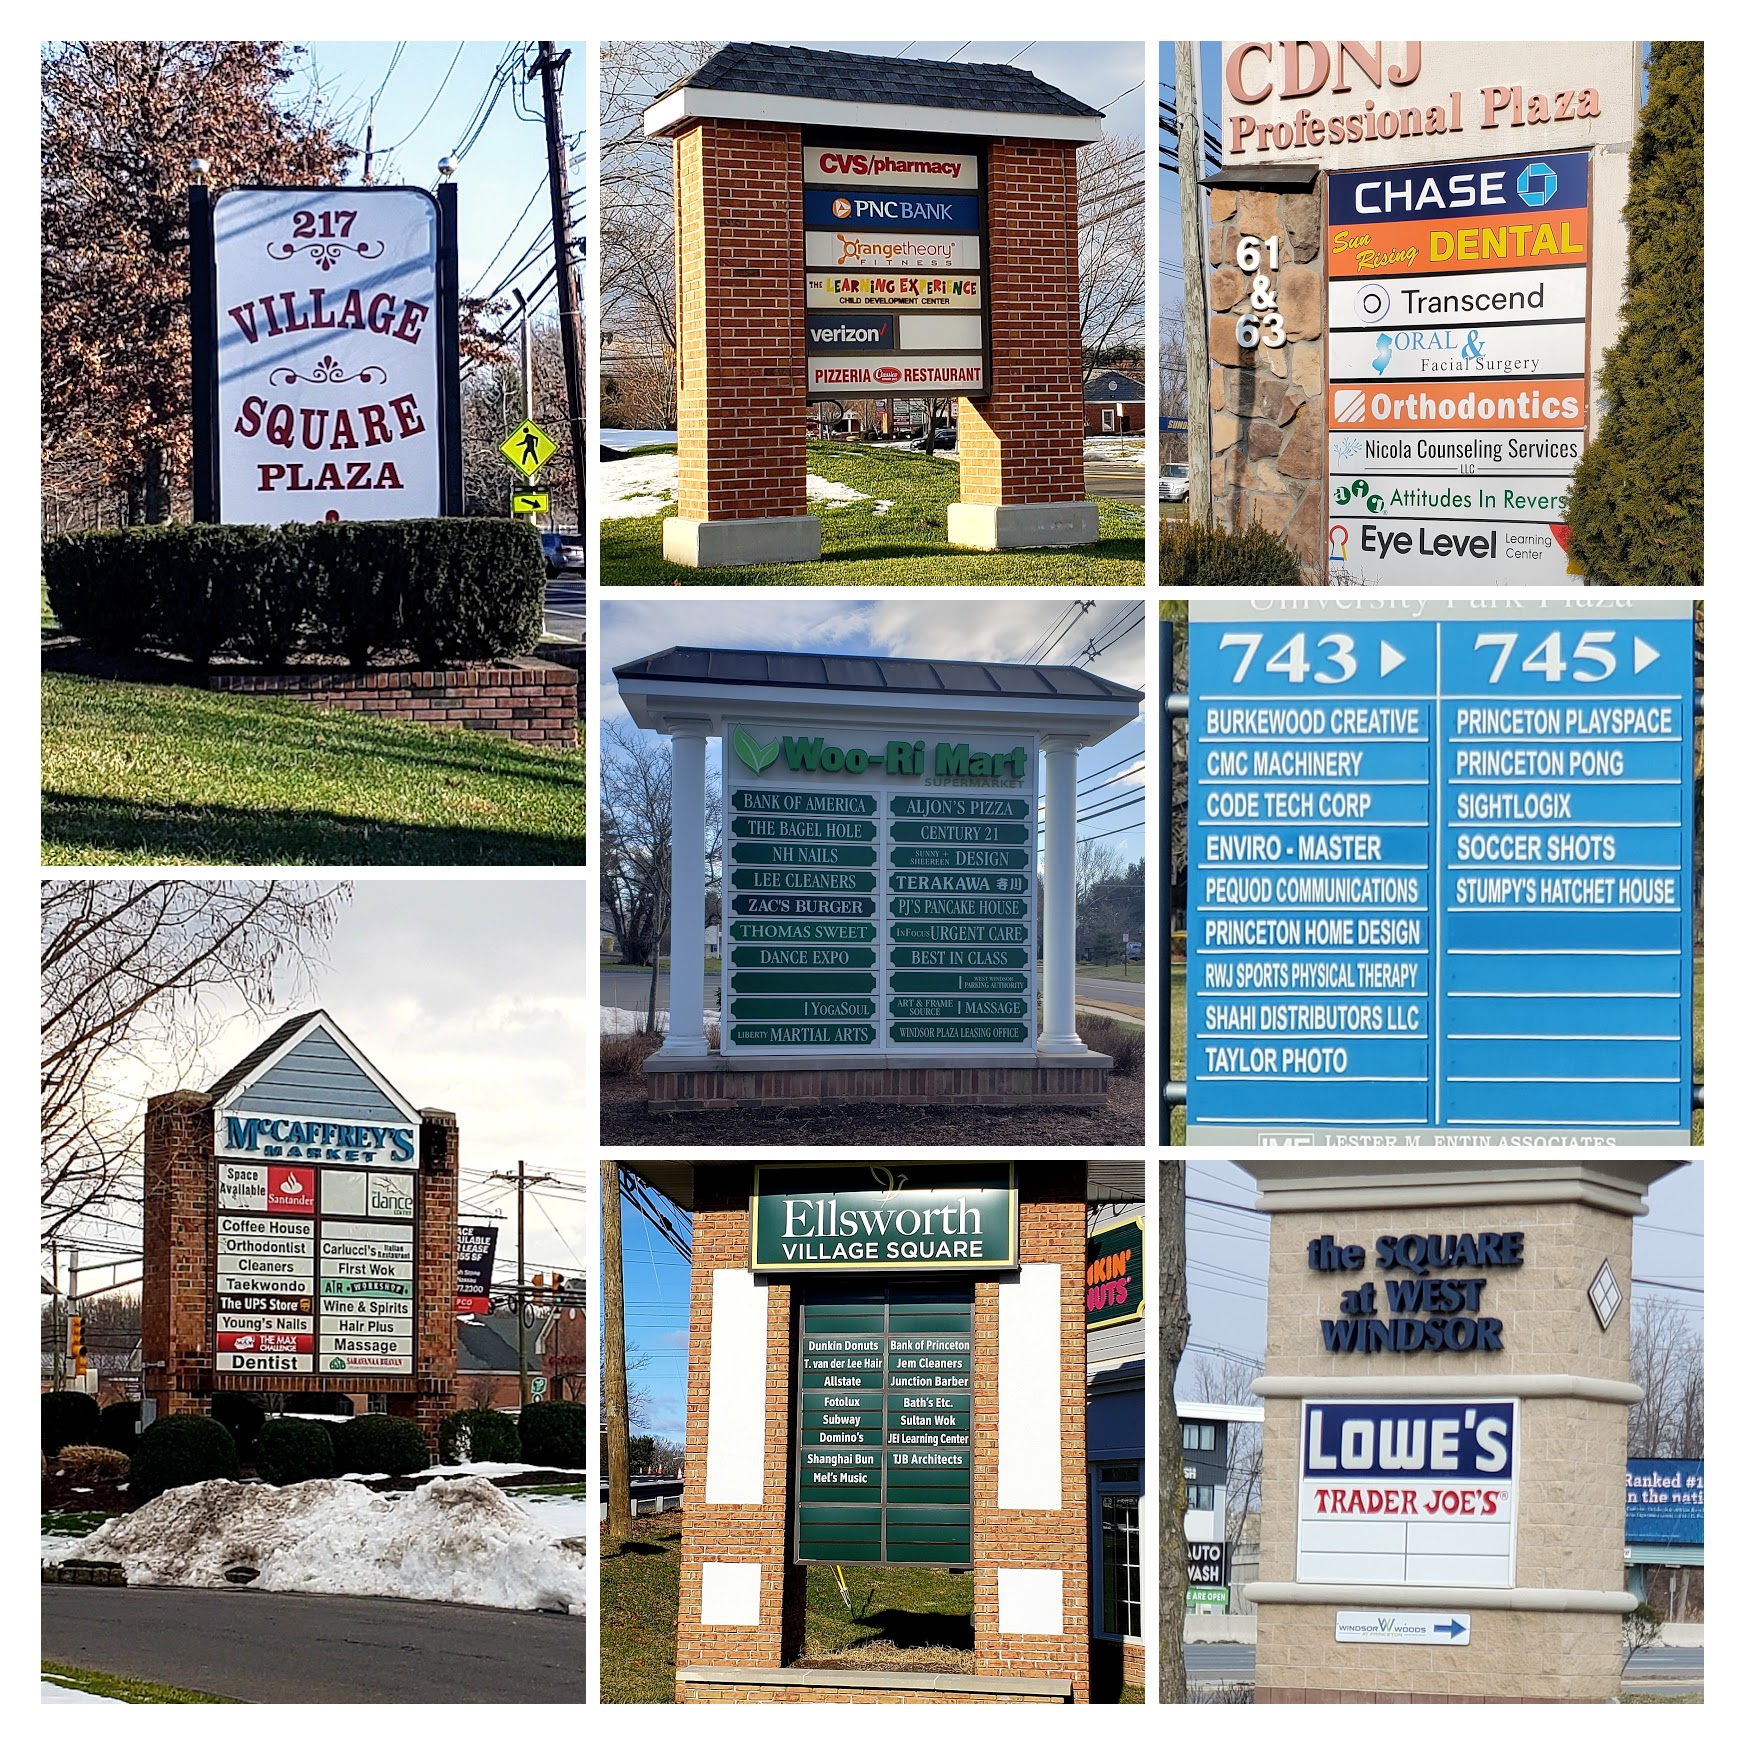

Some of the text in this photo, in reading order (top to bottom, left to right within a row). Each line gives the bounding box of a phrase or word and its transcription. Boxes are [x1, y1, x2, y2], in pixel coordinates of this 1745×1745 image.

[1225, 41, 1423, 104] CDNJ
[1480, 85, 1601, 130] Plaza
[1229, 91, 1463, 155] Professional
[820, 153, 961, 178] CVS/pharmacy
[1355, 171, 1506, 215] CHASE
[292, 210, 358, 239] 217
[1429, 221, 1584, 264] DENTAL
[1235, 236, 1281, 274] 61
[864, 297, 950, 305] DEVELOPMENT CENTER
[1401, 283, 1545, 316] Transcend
[228, 288, 429, 345] VILLAGE
[810, 324, 880, 342] verizon
[1235, 313, 1288, 350] 63
[1394, 331, 1459, 353] ORAL
[815, 368, 871, 384] PIZZERIA
[904, 367, 981, 382] RESTAURANT
[1370, 390, 1580, 423] Orthodontics
[235, 393, 426, 450] SQUARE
[1365, 438, 1578, 464] Nicola Counseling Services
[257, 463, 404, 491] PLAZA
[1389, 488, 1568, 511] Attitudes Revers
[1361, 525, 1497, 560] Eye Level
[1505, 532, 1552, 549] Learning
[1505, 547, 1543, 561] Center
[1218, 632, 1358, 686] 743
[1473, 630, 1617, 684] 745
[1206, 708, 1420, 736] BURKEWOOD CREATIVE
[1456, 707, 1673, 736] PRINCETON PLAYSPACE
[782, 735, 1028, 779] Woo-Ri Mart
[1206, 751, 1363, 777] CMC MACHINERY
[1456, 750, 1625, 776] PRINCETON PONG
[743, 793, 867, 813] BANK OF AMERICA
[907, 799, 1014, 817] ALJON'S PIZZA
[1206, 792, 1372, 819] CODE TECH CORP
[1456, 793, 1572, 820] SIGHTLOGIX
[748, 819, 862, 838] THE BAGEL HOLE
[921, 825, 981, 841] CENTURY
[798, 847, 838, 863] NAILS
[915, 850, 940, 858] SUNNY
[1206, 834, 1382, 862] ENVIRO MASTER
[1456, 835, 1617, 862] SOCCER SHOTS
[955, 850, 1009, 867] DESIGN
[754, 872, 856, 889] LEE CLEANERS
[895, 875, 991, 891] TERAKAWA
[1205, 877, 1419, 904] PEQUOD COMMUNICATIONS
[1456, 877, 1676, 905] STUMPY'S HATCHET HOUSE
[748, 898, 863, 914] ZAC'S BURGER
[924, 899, 1020, 915] PANCAKE HOUSE
[739, 924, 868, 939] THOMAS SWEET
[930, 925, 1022, 941] URGENT CARE
[1205, 919, 1421, 946] PRINCETON HOME DESIGN
[760, 950, 849, 964] DANCE EXPO
[911, 950, 1008, 965] BEST CLASS
[1205, 963, 1419, 989] RWJ SPORTS PHYSICAL THERAPY
[965, 1001, 1021, 1014] MASSAGE
[1205, 1005, 1420, 1031] SHAHI DISTRIBUTORS LLC
[738, 1027, 869, 1042] LIBERTY MARTIAL ARTS
[1205, 1047, 1349, 1074] TAYLOR PHOTO
[371, 1193, 413, 1211] dance
[781, 1197, 984, 1238] Ellsworth
[222, 1219, 310, 1235] Coffee House
[226, 1239, 306, 1254] Orthodontist
[322, 1243, 376, 1257] Carlucci's
[782, 1240, 983, 1260] VILLAGE SQUARE
[1307, 1231, 1525, 1275] the SQUARE
[238, 1259, 294, 1272] Cleaners
[369, 1264, 395, 1276] Wok
[226, 1278, 306, 1292] Taekwondo
[220, 1297, 267, 1311] The UPS
[1340, 1278, 1487, 1316] at WEST
[323, 1300, 354, 1313] Wine
[1320, 1317, 1505, 1354] WINDSOR
[334, 1338, 397, 1354] Massage
[808, 1341, 878, 1351] Dunkin Donuts
[890, 1340, 970, 1350] Bank Princeton
[232, 1355, 297, 1370] Dentist
[919, 1358, 963, 1369] Cleaners
[824, 1376, 862, 1387] Allstate
[890, 1376, 969, 1387] Junction Barber
[824, 1397, 860, 1407] Fotolux
[822, 1414, 861, 1427] Subway
[900, 1415, 956, 1426] Sultan Wok
[819, 1432, 864, 1443] Domino's
[902, 1434, 969, 1446] Learning Center
[1309, 1408, 1508, 1473] LOWE'S
[807, 1454, 874, 1467] Shanghai Bun
[911, 1454, 963, 1465] Architects
[840, 1472, 867, 1483] Music
[1625, 1472, 1681, 1488] Ranked
[1314, 1489, 1500, 1516] TRADER JOE'S
[1642, 1488, 1668, 1503] the
[1207, 1591, 1226, 1602] OPEN
